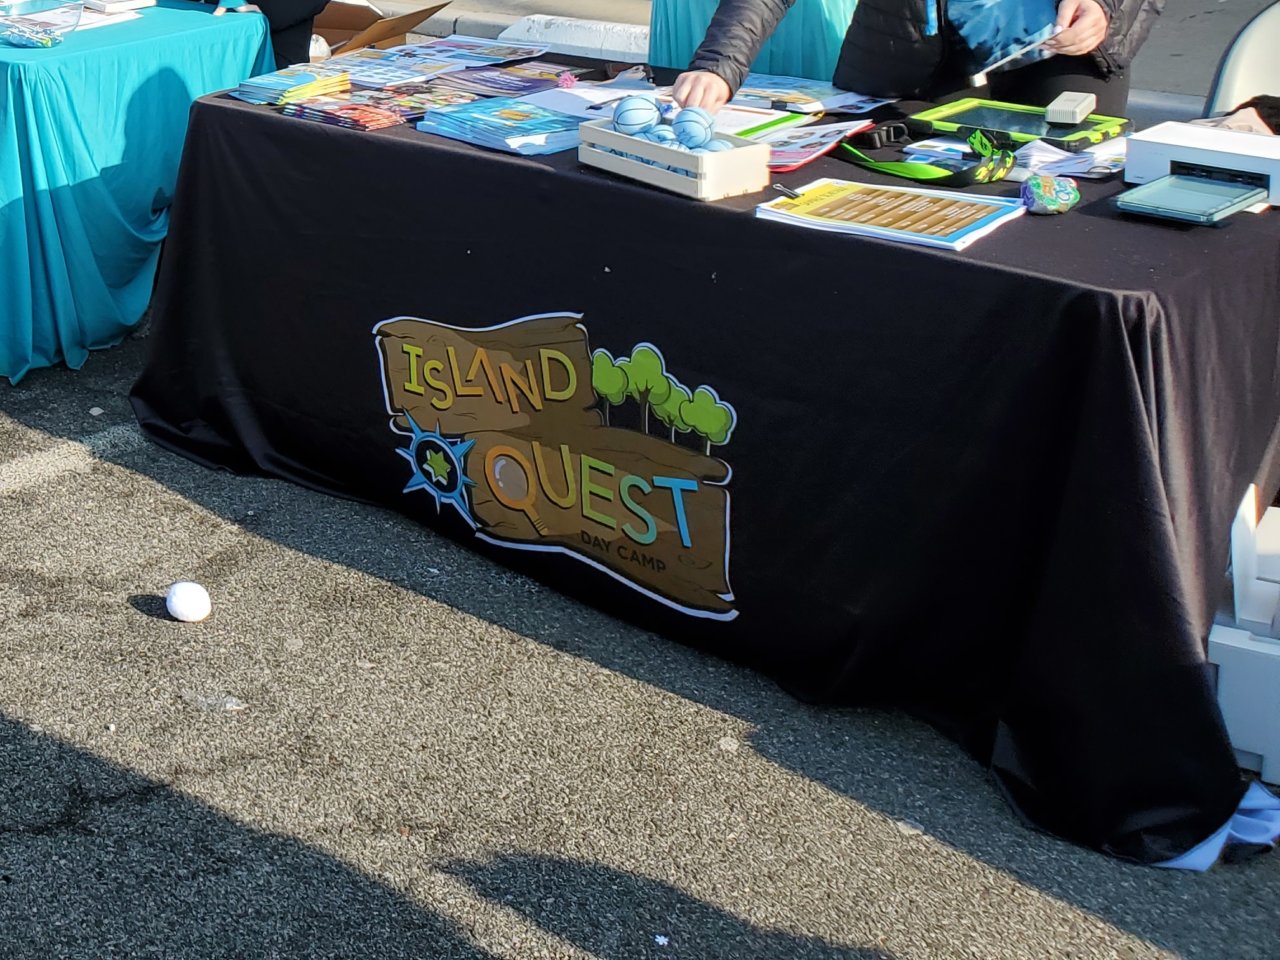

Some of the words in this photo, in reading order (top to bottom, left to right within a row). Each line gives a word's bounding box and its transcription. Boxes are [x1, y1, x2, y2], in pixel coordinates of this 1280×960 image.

[401, 343, 578, 414] ISLAND
[484, 440, 699, 549] QUEST
[581, 529, 611, 553] DAY
[617, 545, 667, 573] CAMP
